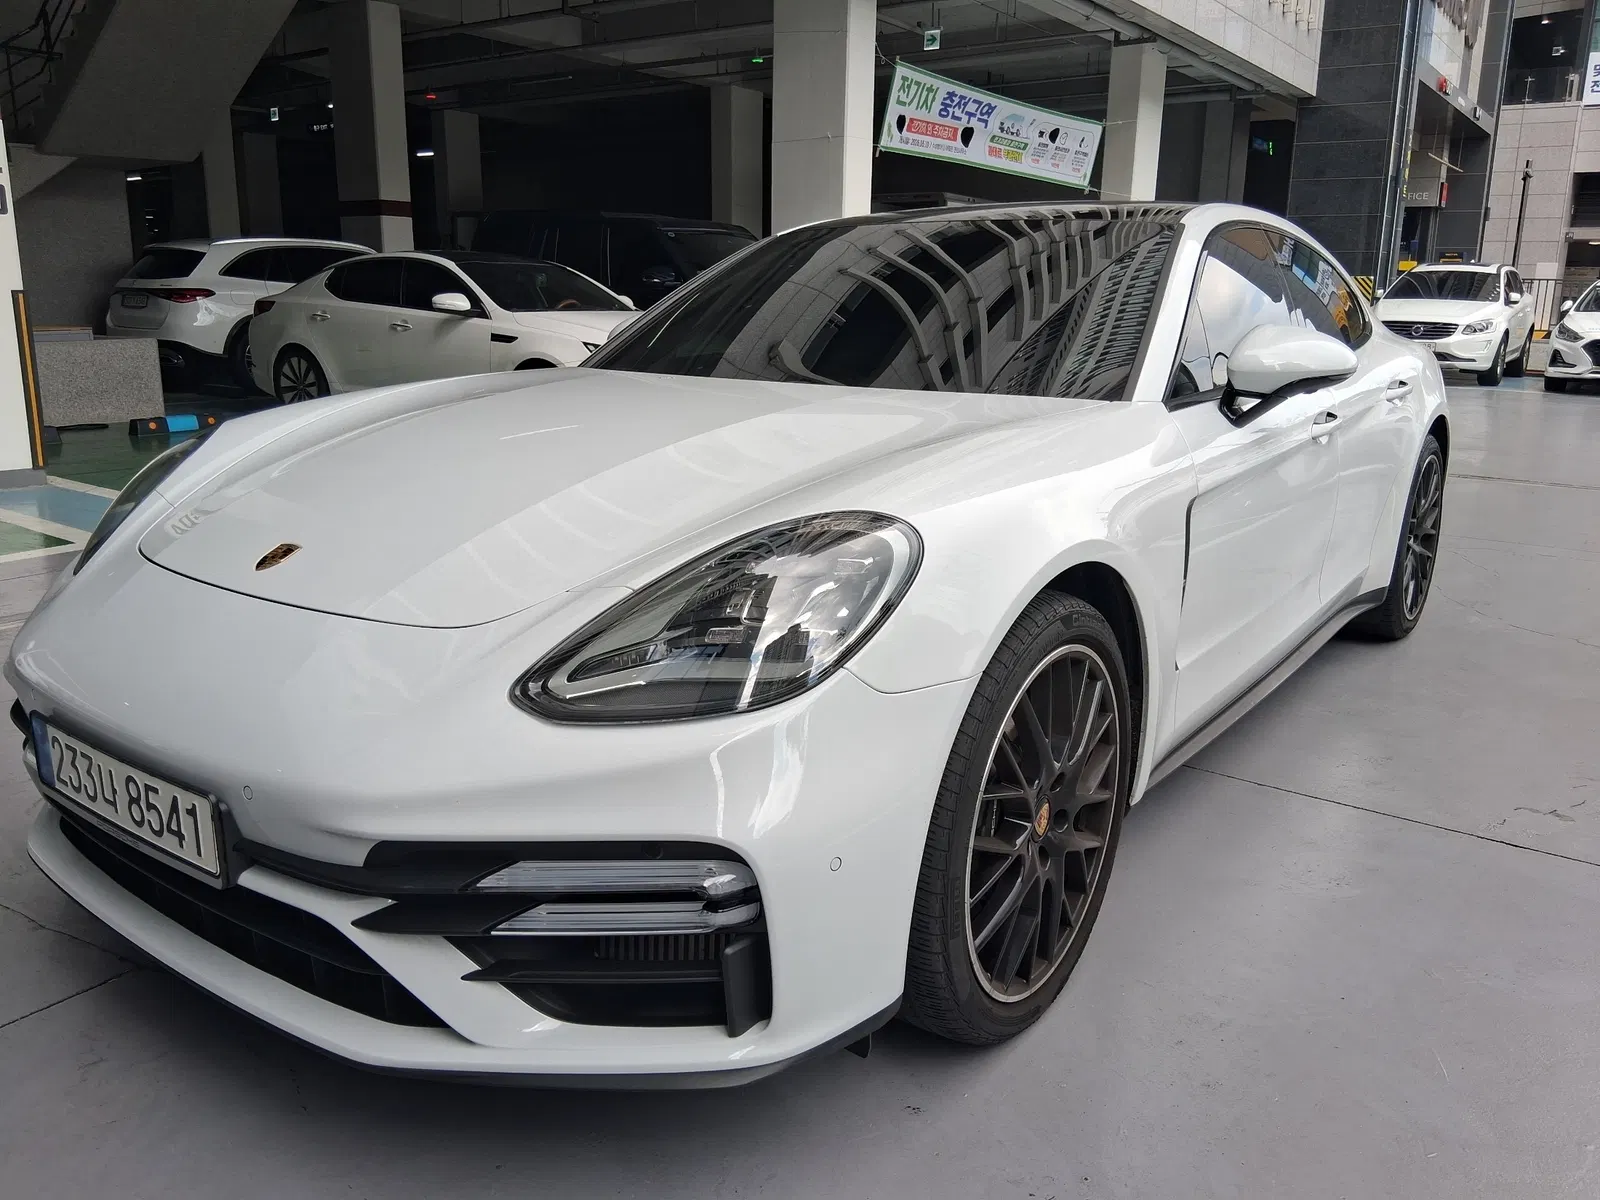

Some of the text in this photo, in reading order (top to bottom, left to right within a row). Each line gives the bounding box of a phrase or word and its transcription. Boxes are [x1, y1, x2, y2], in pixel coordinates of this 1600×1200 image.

[896, 75, 998, 129] 전기차 충전구역
[1407, 192, 1429, 200] FICE
[51, 735, 203, 858] 233나 8541
